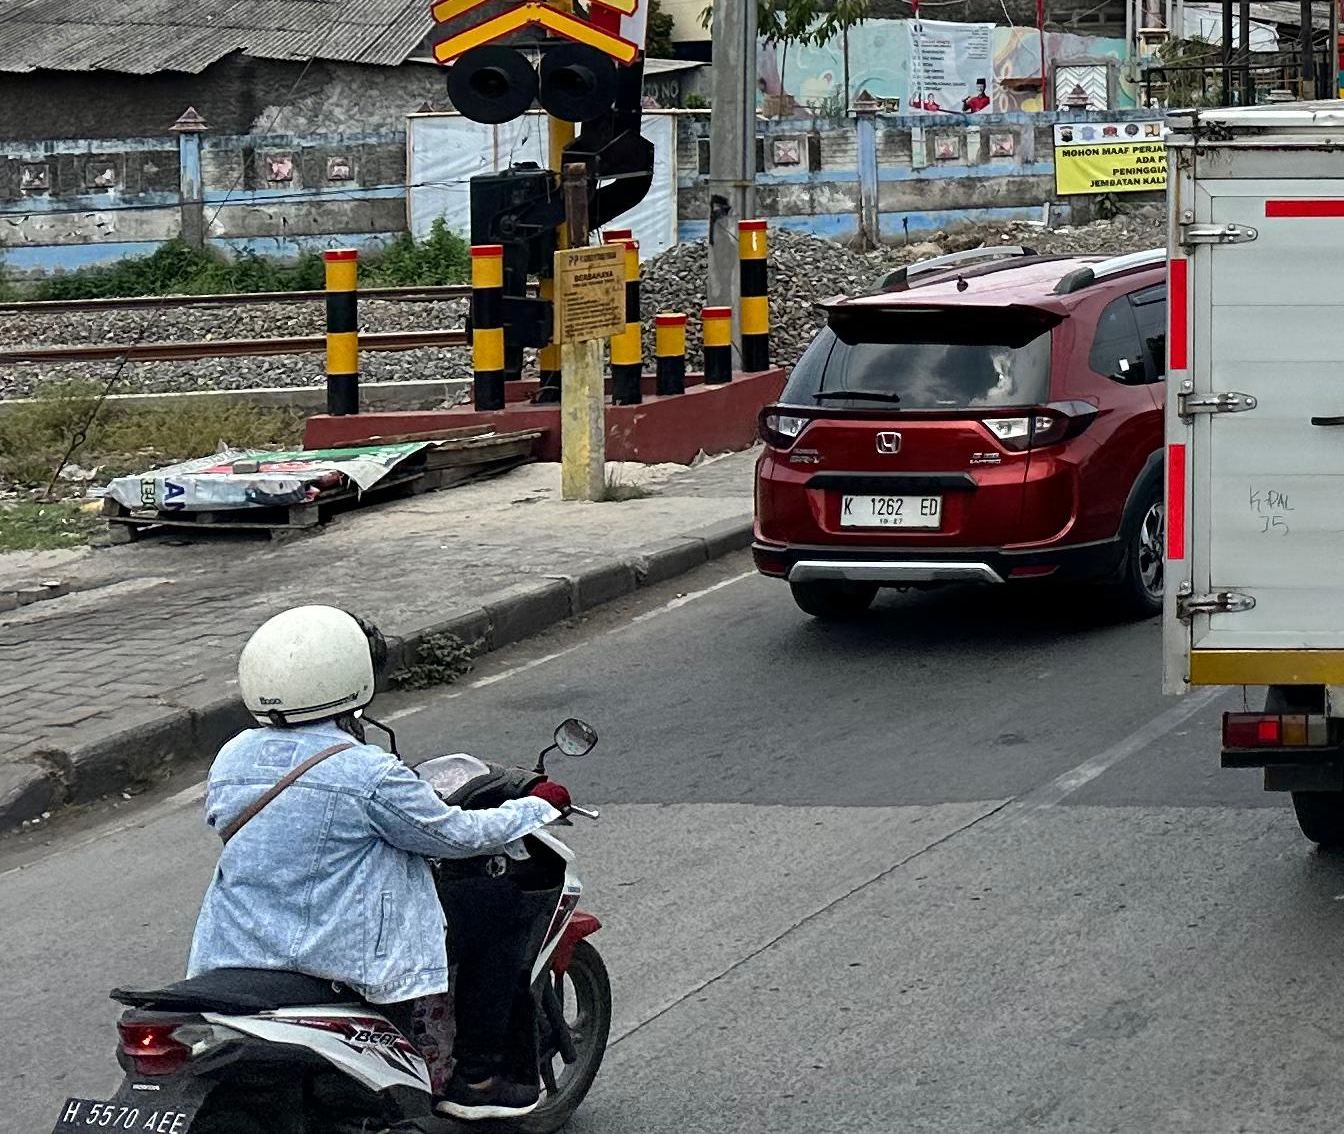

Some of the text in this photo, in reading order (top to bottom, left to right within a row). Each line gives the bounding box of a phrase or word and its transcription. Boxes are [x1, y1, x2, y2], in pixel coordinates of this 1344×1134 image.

[1062, 149, 1099, 157] MOHON
[1102, 147, 1129, 155] MAAF
[1090, 179, 1140, 187] JEMBATAN
[843, 497, 938, 516] K 1262 ED
[63, 1102, 186, 1134] H 5570 AEE
